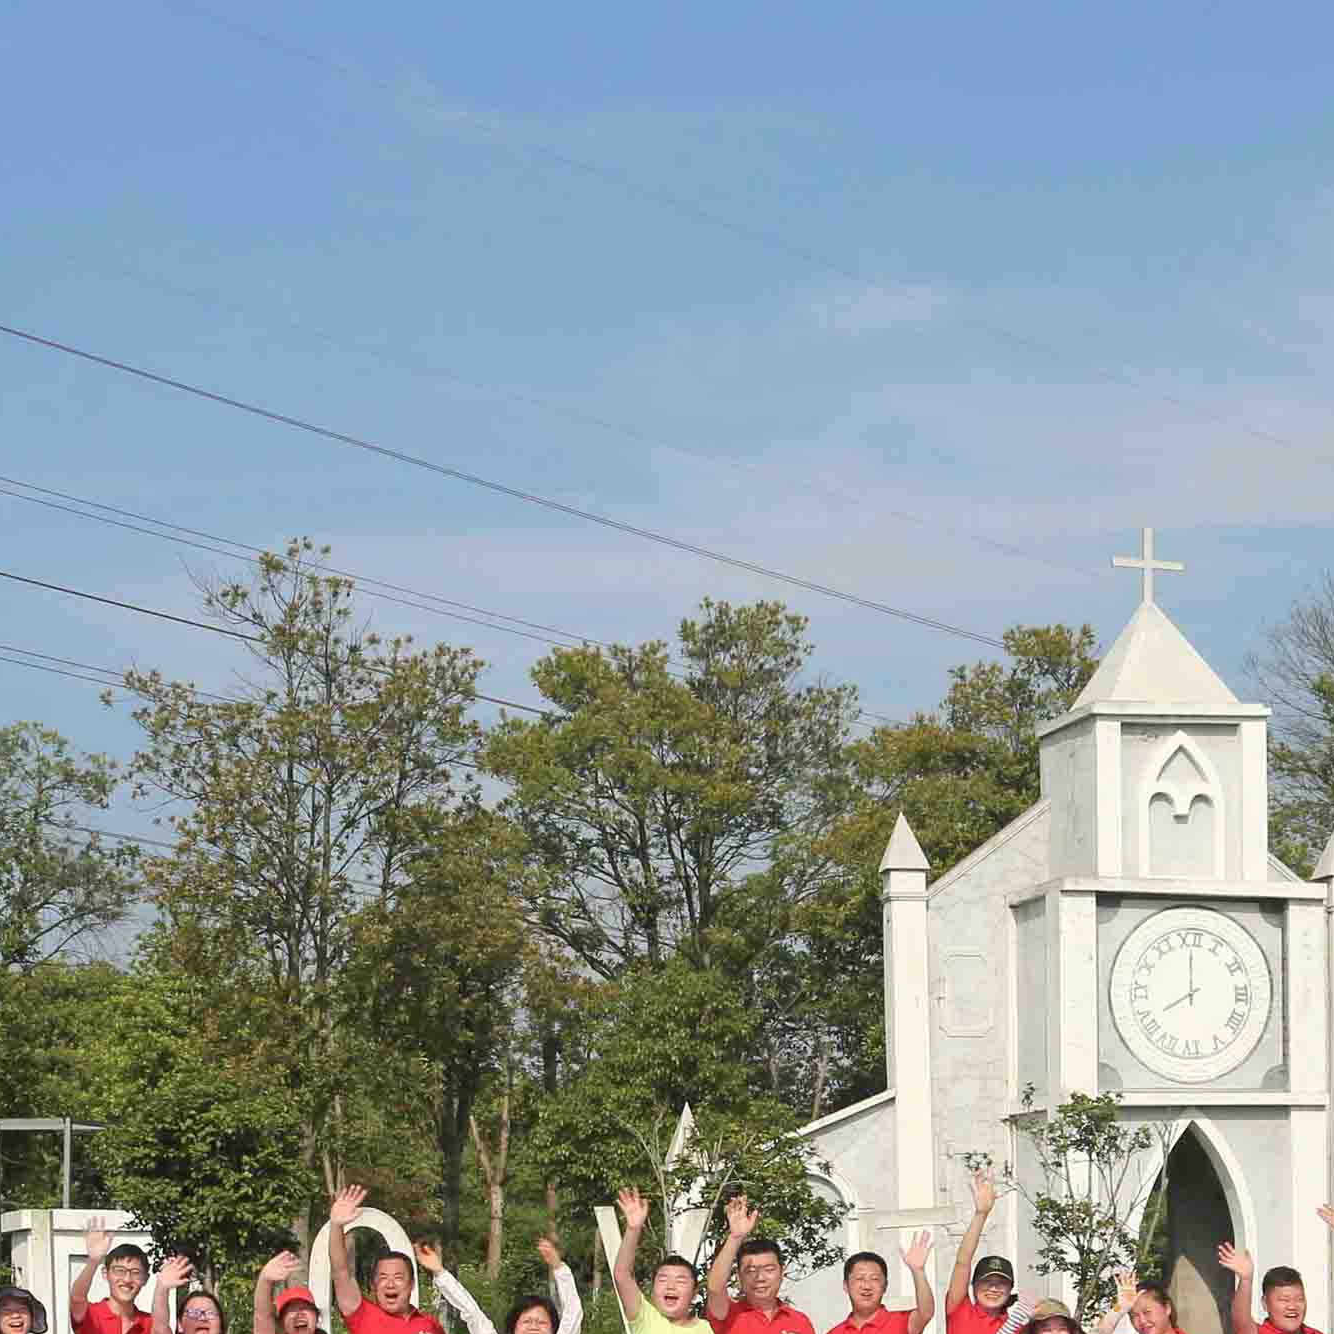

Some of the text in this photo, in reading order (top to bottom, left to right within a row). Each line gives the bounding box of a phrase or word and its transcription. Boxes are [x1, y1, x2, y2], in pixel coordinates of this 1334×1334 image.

[1151, 936, 1176, 960] XI
[1177, 932, 1204, 949] XII
[1208, 939, 1224, 957] I
[1137, 956, 1155, 976] X
[1225, 957, 1244, 976] II
[1133, 979, 1148, 1000] IX
[1234, 984, 1248, 1006] III
[1137, 1009, 1162, 1037] VIII
[1155, 1031, 1179, 1052] VII
[1182, 1039, 1202, 1056] VI
[1212, 1034, 1226, 1050] V
